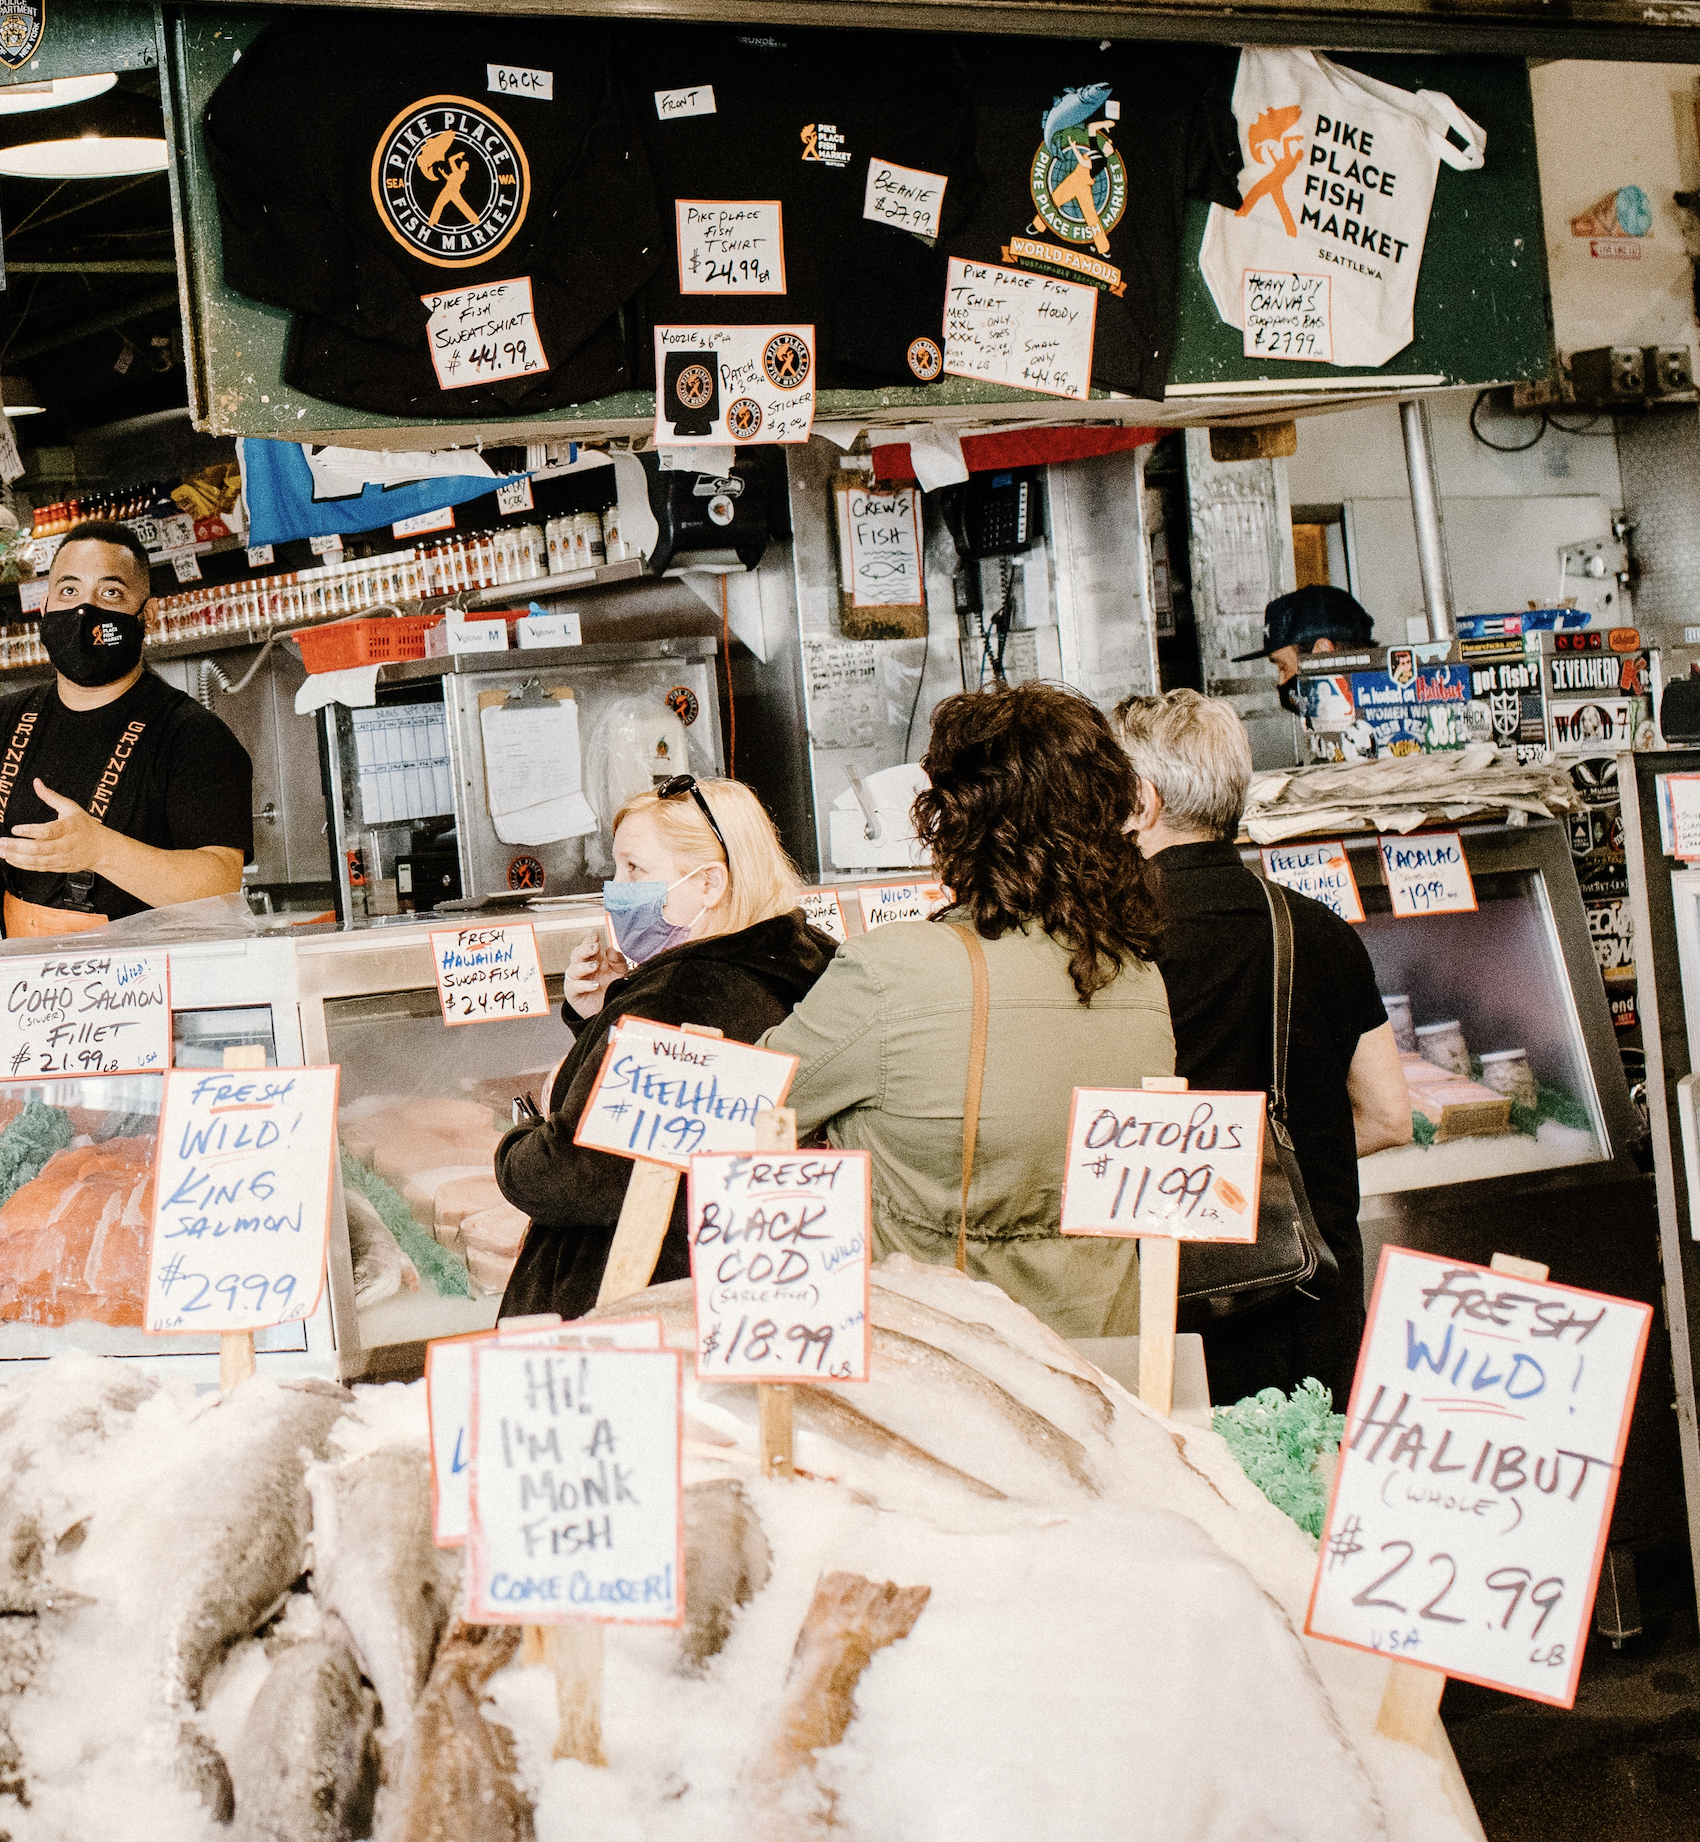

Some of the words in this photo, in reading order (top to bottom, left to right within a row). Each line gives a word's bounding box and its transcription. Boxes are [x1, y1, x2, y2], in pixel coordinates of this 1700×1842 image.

[19, 42, 33, 58] NEW
[29, 22, 40, 42] YORK
[499, 70, 544, 91] BACK
[661, 91, 699, 113] FRONT
[389, 118, 432, 169] PIKE
[444, 112, 509, 164] PLACE
[818, 124, 837, 134] PIKE
[818, 133, 845, 144] PLACE
[1315, 113, 1374, 156] PIKE
[818, 142, 836, 151] FISH
[818, 150, 852, 162] MARKET
[386, 178, 404, 189] SEA
[499, 174, 516, 184] WA
[1033, 152, 1049, 190] PIKE
[1309, 144, 1397, 197] PLACE
[874, 170, 938, 203] BEANIE
[1102, 163, 1124, 228] MARKET
[1304, 173, 1365, 216] FISH
[392, 197, 432, 242] FISH
[442, 194, 513, 250] MARKET
[687, 208, 715, 223] PIKE
[719, 210, 762, 227] PLACE
[1037, 194, 1070, 237] PLACE
[1073, 223, 1102, 239] FISH
[1300, 203, 1409, 264] MARKET
[1013, 239, 1062, 262] WORLD
[1066, 252, 1118, 283] FAMOUS
[964, 265, 986, 279] PIKE
[994, 273, 1035, 287] PLACE
[1248, 273, 1286, 294] HEAVY
[1291, 273, 1323, 294] DUTY
[432, 296, 462, 312] PIKE
[468, 286, 509, 307] PLACE
[967, 295, 1007, 309] SHIRT
[1250, 295, 1316, 312] CANVAS
[947, 308, 969, 318] MED
[950, 321, 974, 330] XXL
[987, 315, 1010, 326] ONLY
[1038, 302, 1078, 325] HOODY
[661, 329, 698, 344] KOOZIE
[949, 332, 981, 344] XXXL
[720, 360, 755, 390] PATCH
[768, 393, 812, 416] STICKER
[852, 498, 910, 518] CREWS
[857, 523, 909, 546] FISH
[489, 630, 499, 640] M
[564, 625, 571, 634] L
[1472, 666, 1497, 696] got
[1499, 662, 1538, 690] fish?
[1551, 657, 1620, 690] SEVERHEAD
[1415, 675, 1465, 702] Halibut
[1270, 849, 1332, 873] PEELED
[1383, 845, 1460, 872] BACALAO
[880, 885, 918, 904] WILD!
[870, 908, 922, 923] MEDIUM
[458, 929, 505, 946] FRESH
[442, 943, 513, 970] HAWAIIAN
[41, 958, 111, 978] FRESH
[116, 959, 151, 986] WILD!
[7, 981, 73, 1013] COHO
[79, 982, 163, 1013] SALMON
[19, 1009, 66, 1031] (SILVER)
[104, 1060, 119, 1072] LB
[138, 1051, 158, 1067] USA
[653, 1040, 718, 1066] WHOLE
[192, 1074, 296, 1105] FRESH
[600, 1055, 775, 1126] STEELHEAD
[179, 1112, 302, 1160] WILD!
[1084, 1102, 1242, 1153] OCTOPUS
[724, 1157, 843, 1191] FRESH
[161, 1167, 276, 1211] KING
[164, 1202, 303, 1239] SALMON
[695, 1203, 834, 1245] BLACK
[718, 1249, 809, 1285] COD
[1421, 1269, 1606, 1345] FRESH
[153, 1316, 185, 1331] USA
[1404, 1319, 1587, 1416] WILD!
[501, 1417, 563, 1468] I'M
[581, 1418, 620, 1457] A
[1350, 1384, 1624, 1503] HALIBUT
[519, 1458, 641, 1512] MONK
[1381, 1470, 1524, 1535] (WHOLE)
[520, 1514, 616, 1559] FISH
[490, 1570, 560, 1605] COME
[569, 1563, 673, 1612] CLOSER!
[1369, 1626, 1423, 1650] USA
[1530, 1644, 1566, 1667] LB
